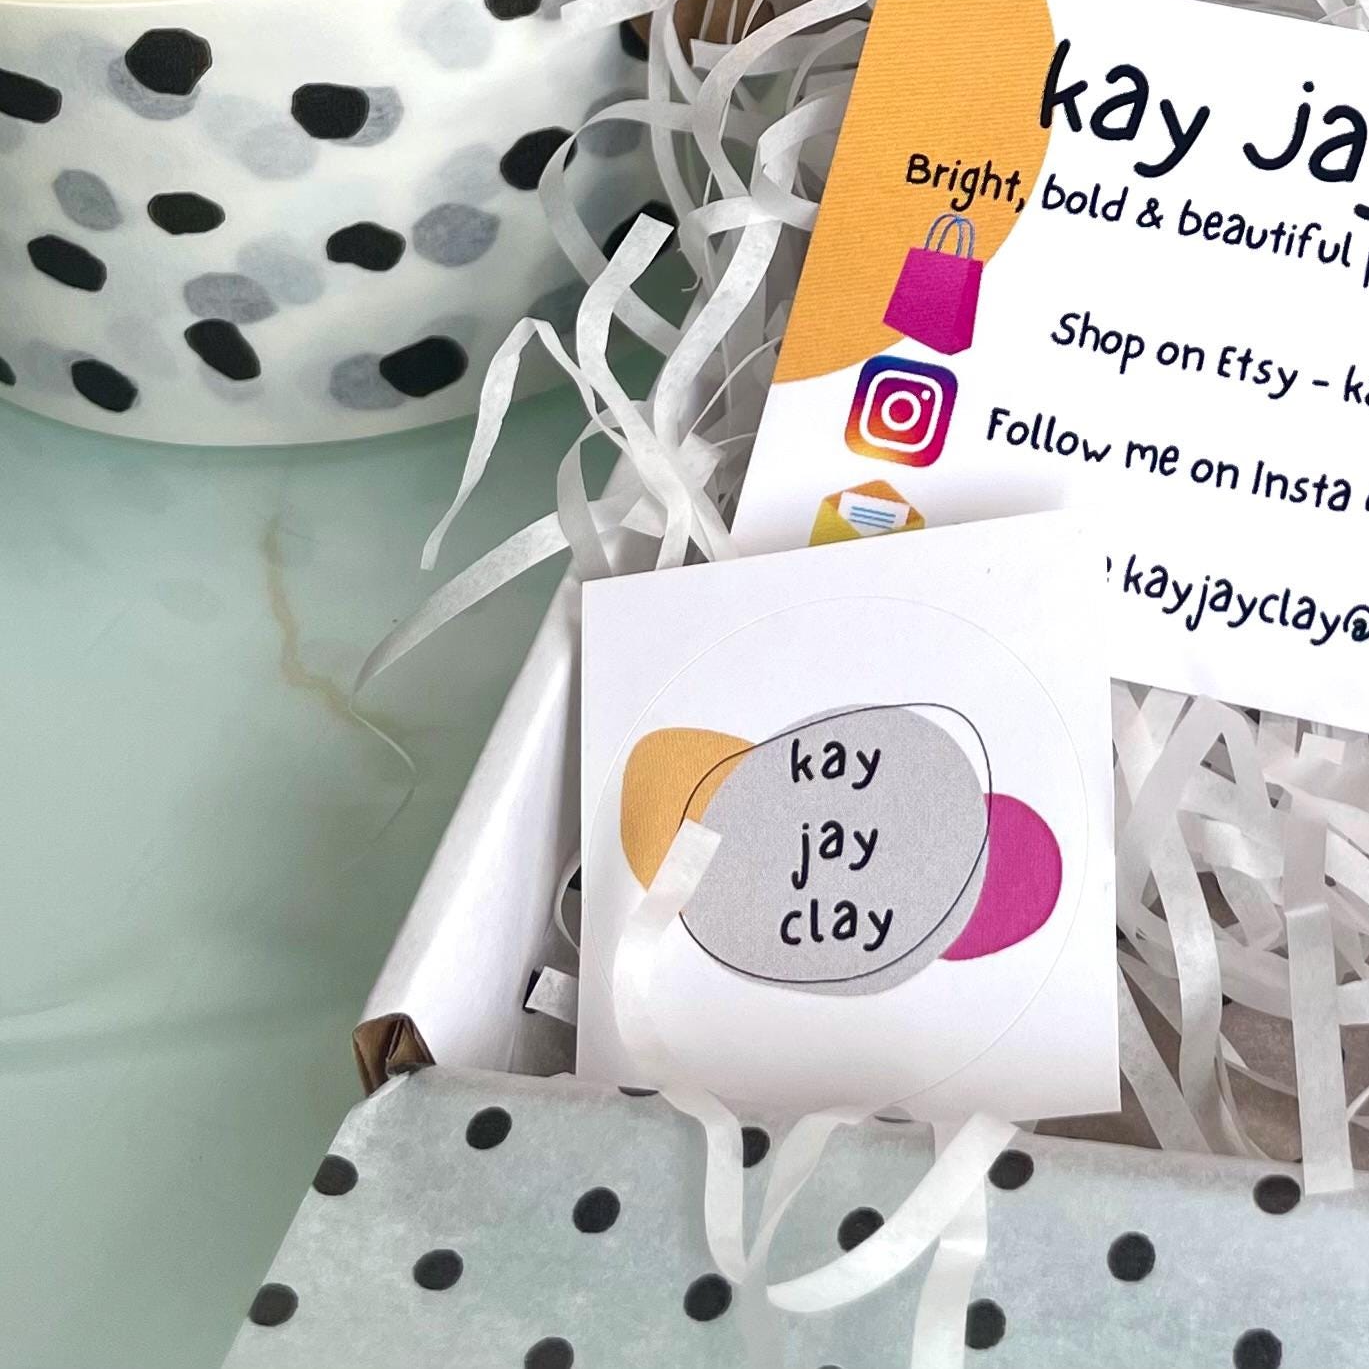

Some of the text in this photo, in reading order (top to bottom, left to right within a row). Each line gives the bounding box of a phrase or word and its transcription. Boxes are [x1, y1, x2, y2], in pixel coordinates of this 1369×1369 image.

[1038, 38, 1211, 179] kay
[906, 153, 1025, 214] Bright,
[1041, 173, 1129, 222] bold
[1135, 197, 1164, 230] &
[1177, 198, 1353, 268] beautiful
[1051, 311, 1145, 375] Shop
[1156, 341, 1205, 372] on
[1217, 345, 1299, 400] Etsy
[987, 407, 1112, 463] Follow
[1125, 440, 1180, 477] me
[1190, 458, 1240, 490] on
[1251, 460, 1352, 512] Insta
[790, 738, 882, 791] kay
[791, 820, 879, 890] jay
[780, 898, 894, 952] clay
